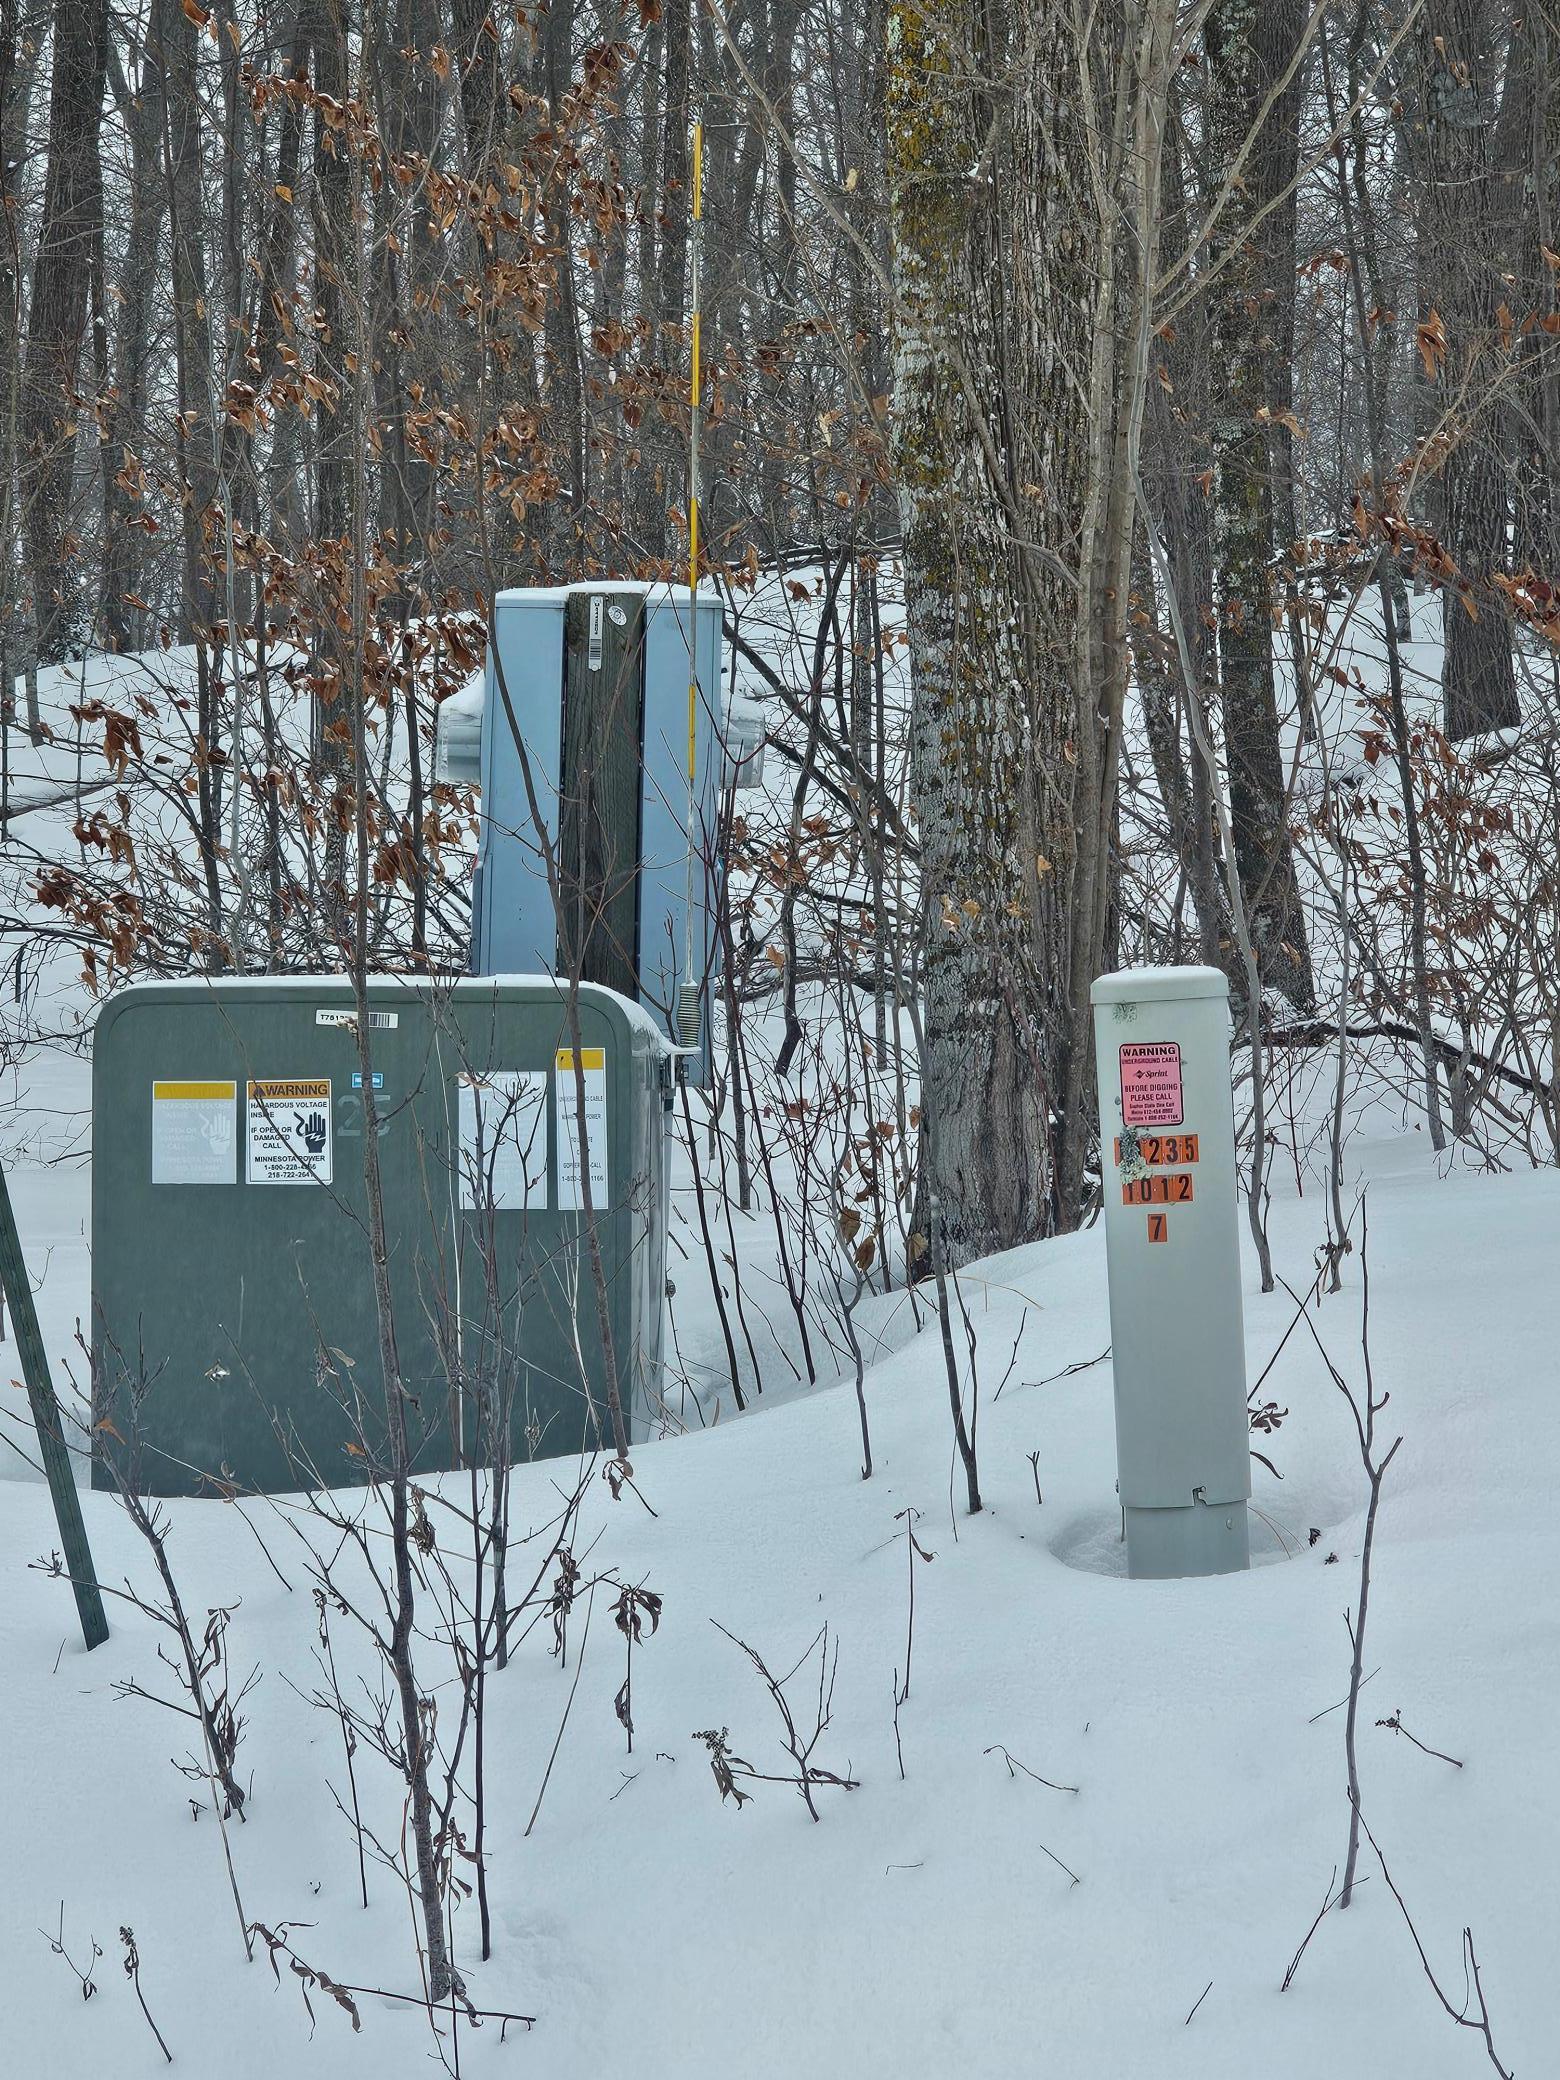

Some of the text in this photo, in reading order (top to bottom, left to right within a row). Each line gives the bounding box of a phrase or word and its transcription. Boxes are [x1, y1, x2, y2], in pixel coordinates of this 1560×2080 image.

[1122, 1047, 1176, 1057] WARNING
[1144, 1070, 1168, 1079] Sprint
[265, 1084, 328, 1096] WARNING
[1125, 1083, 1178, 1092] BEFORE DIGGING
[1130, 1094, 1154, 1102] PLEASE
[254, 1155, 297, 1163] MINNESOTA
[1126, 1175, 1191, 1202] 1012
[1150, 1215, 1162, 1241] 7
